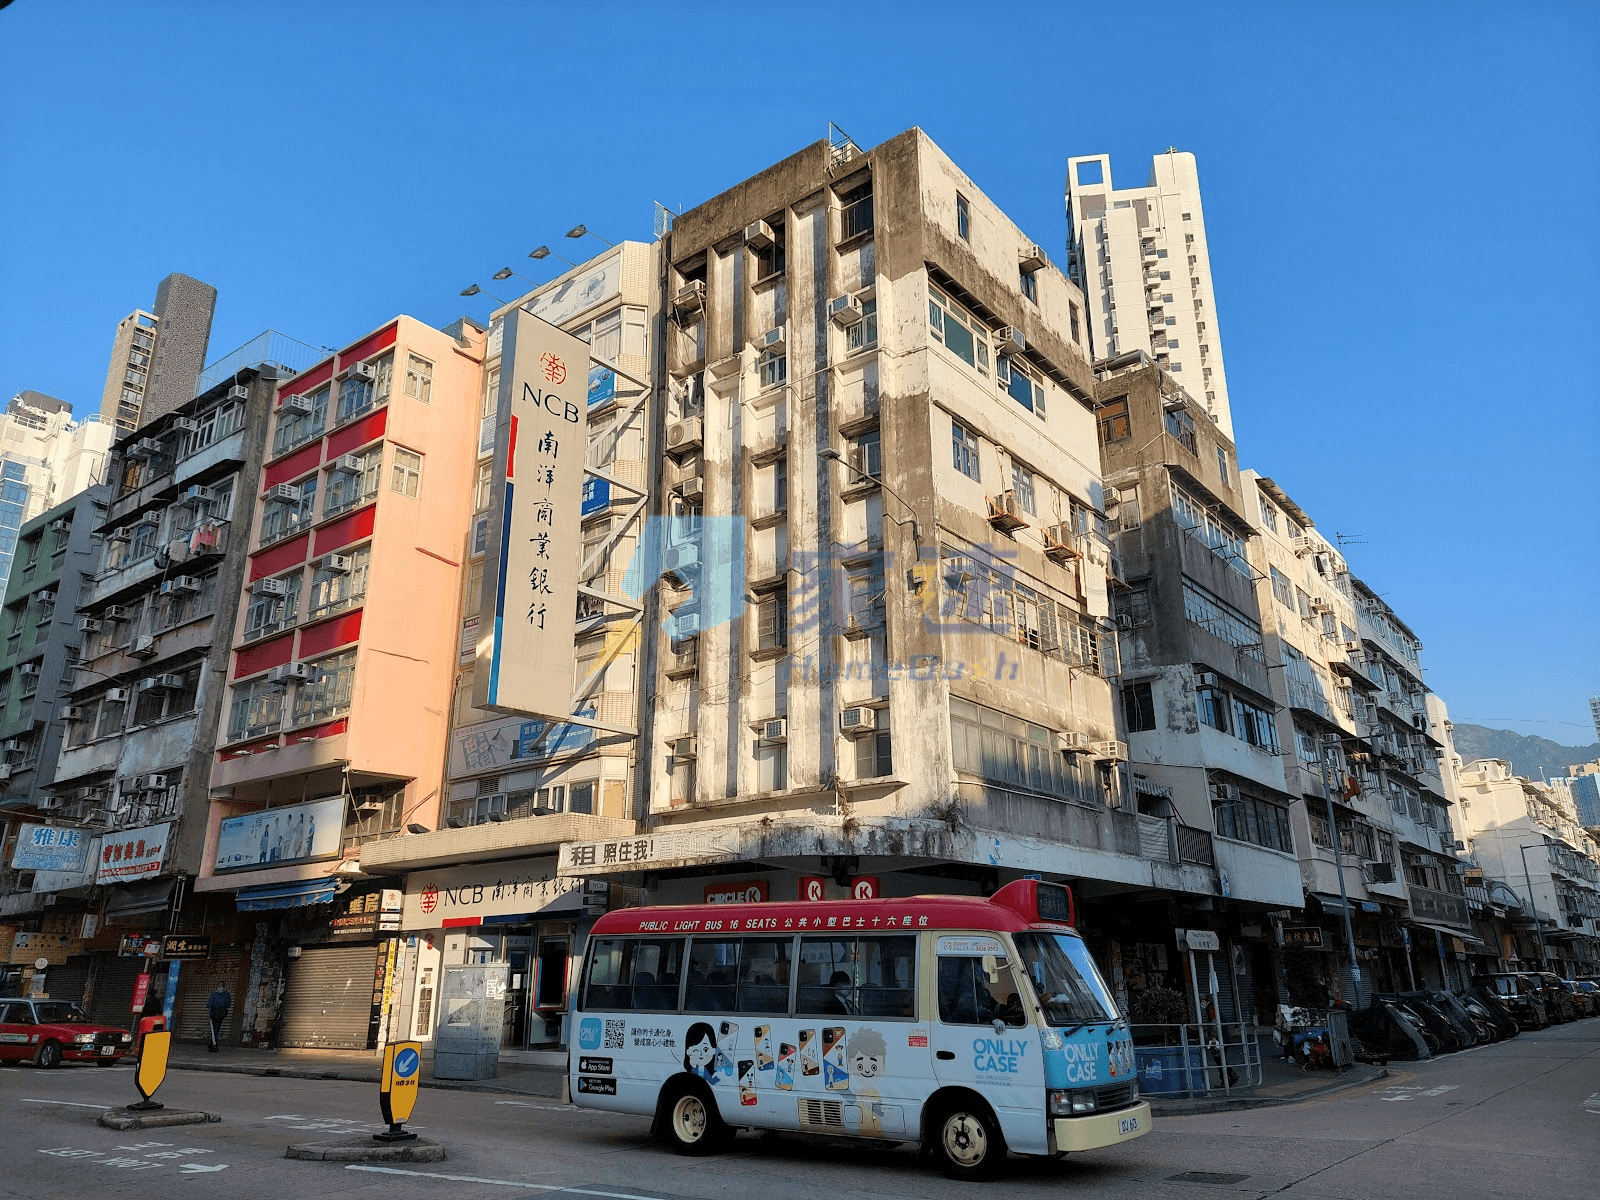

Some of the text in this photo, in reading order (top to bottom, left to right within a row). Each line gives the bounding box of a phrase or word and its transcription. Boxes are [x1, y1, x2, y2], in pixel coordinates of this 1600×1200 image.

[522, 382, 579, 423] NCB
[526, 430, 560, 630] 南洋商業銀行
[32, 828, 81, 847] 雅康
[570, 845, 597, 866] 租
[603, 839, 654, 864] 照住我!
[444, 884, 484, 907] NCB
[492, 874, 582, 902] 南洋商業銀行
[707, 891, 745, 904] CIRCLE
[811, 885, 820, 901] K
[859, 886, 871, 900] K
[639, 918, 777, 931] PUBLIC LIGHT BUS 16 SEATS
[973, 1038, 1028, 1056] ONLLY
[1064, 1042, 1099, 1063] ONLLY
[973, 1055, 1019, 1073] CASE
[1066, 1061, 1097, 1083] CASE
[588, 1084, 614, 1093] Google Play
